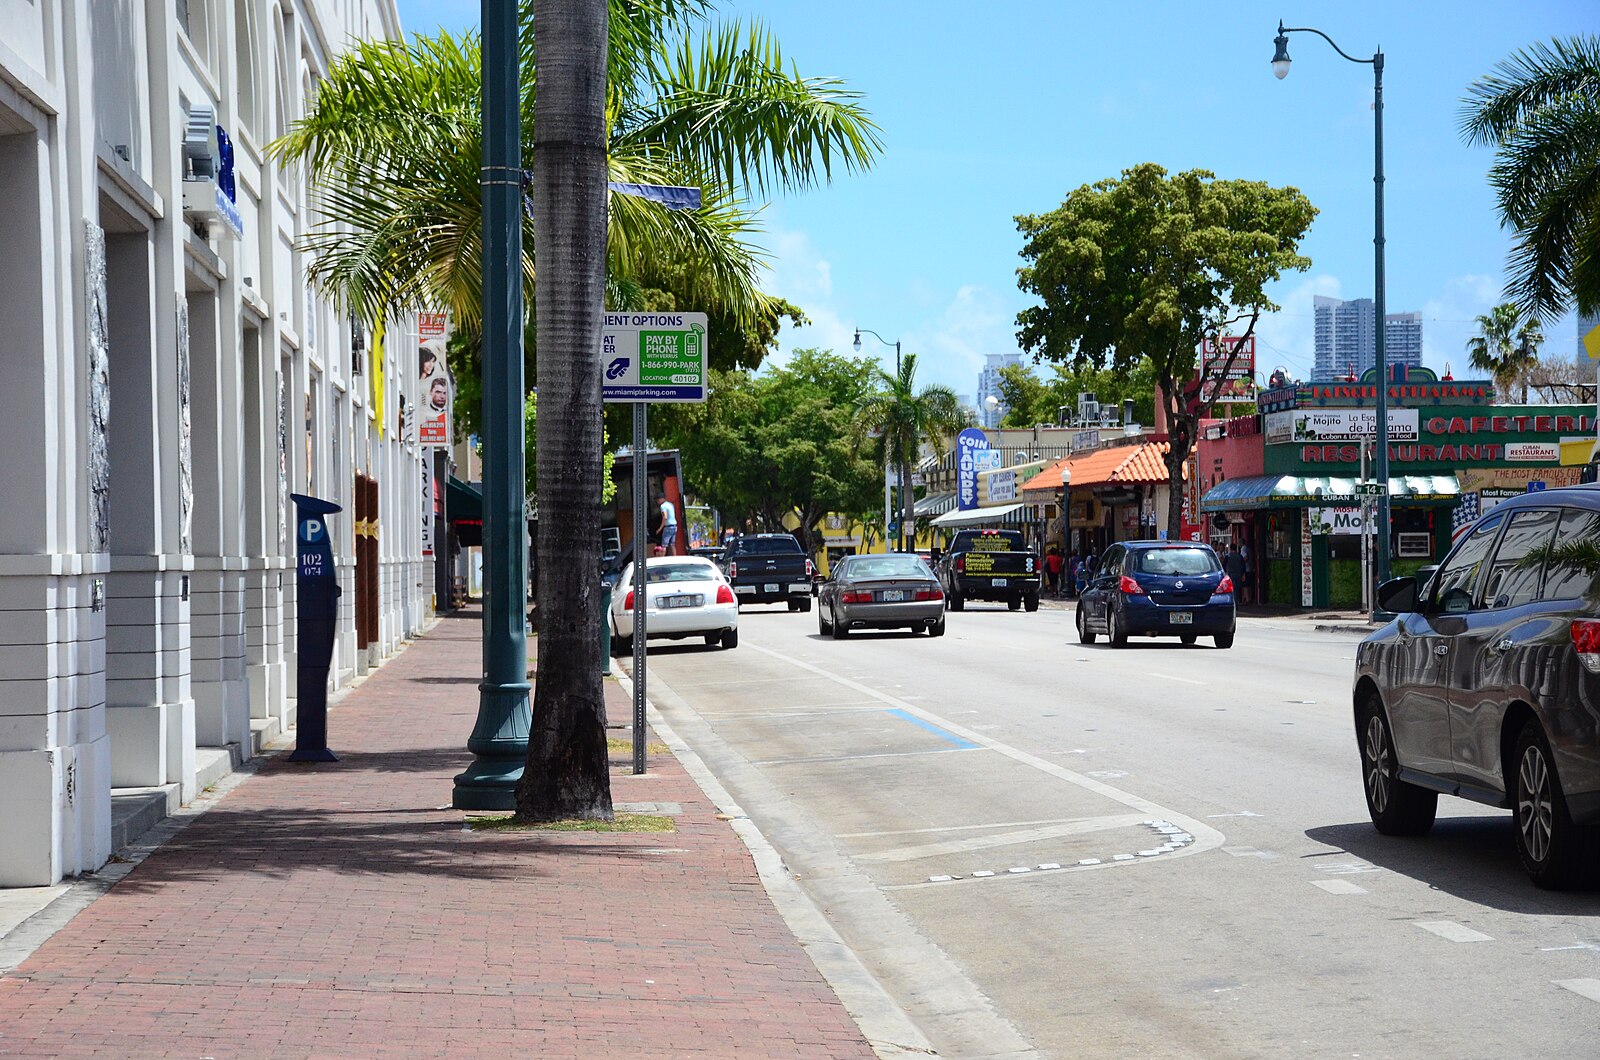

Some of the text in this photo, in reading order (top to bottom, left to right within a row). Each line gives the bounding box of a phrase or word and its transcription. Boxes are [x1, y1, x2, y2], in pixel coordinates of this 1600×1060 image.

[632, 316, 683, 326] OPTIONS
[646, 336, 678, 345] PAY BY
[646, 345, 678, 354] PHONE
[642, 361, 700, 369] 1-866-990-PARK
[674, 375, 697, 383] 40102
[1313, 418, 1341, 427] Mojito
[1348, 414, 1358, 422] La
[1349, 422, 1363, 433] de
[1387, 424, 1412, 432] ama
[1428, 415, 1598, 434] CAFETERI
[959, 435, 988, 450] COIN
[960, 446, 974, 505] LAUNDRY
[1494, 470, 1509, 479] THE
[1510, 469, 1532, 479] MOST
[1532, 468, 1565, 480] FAMOUS
[1365, 484, 1377, 495] 14
[306, 519, 321, 542] P
[301, 553, 322, 566] 102
[304, 567, 321, 576] 074
